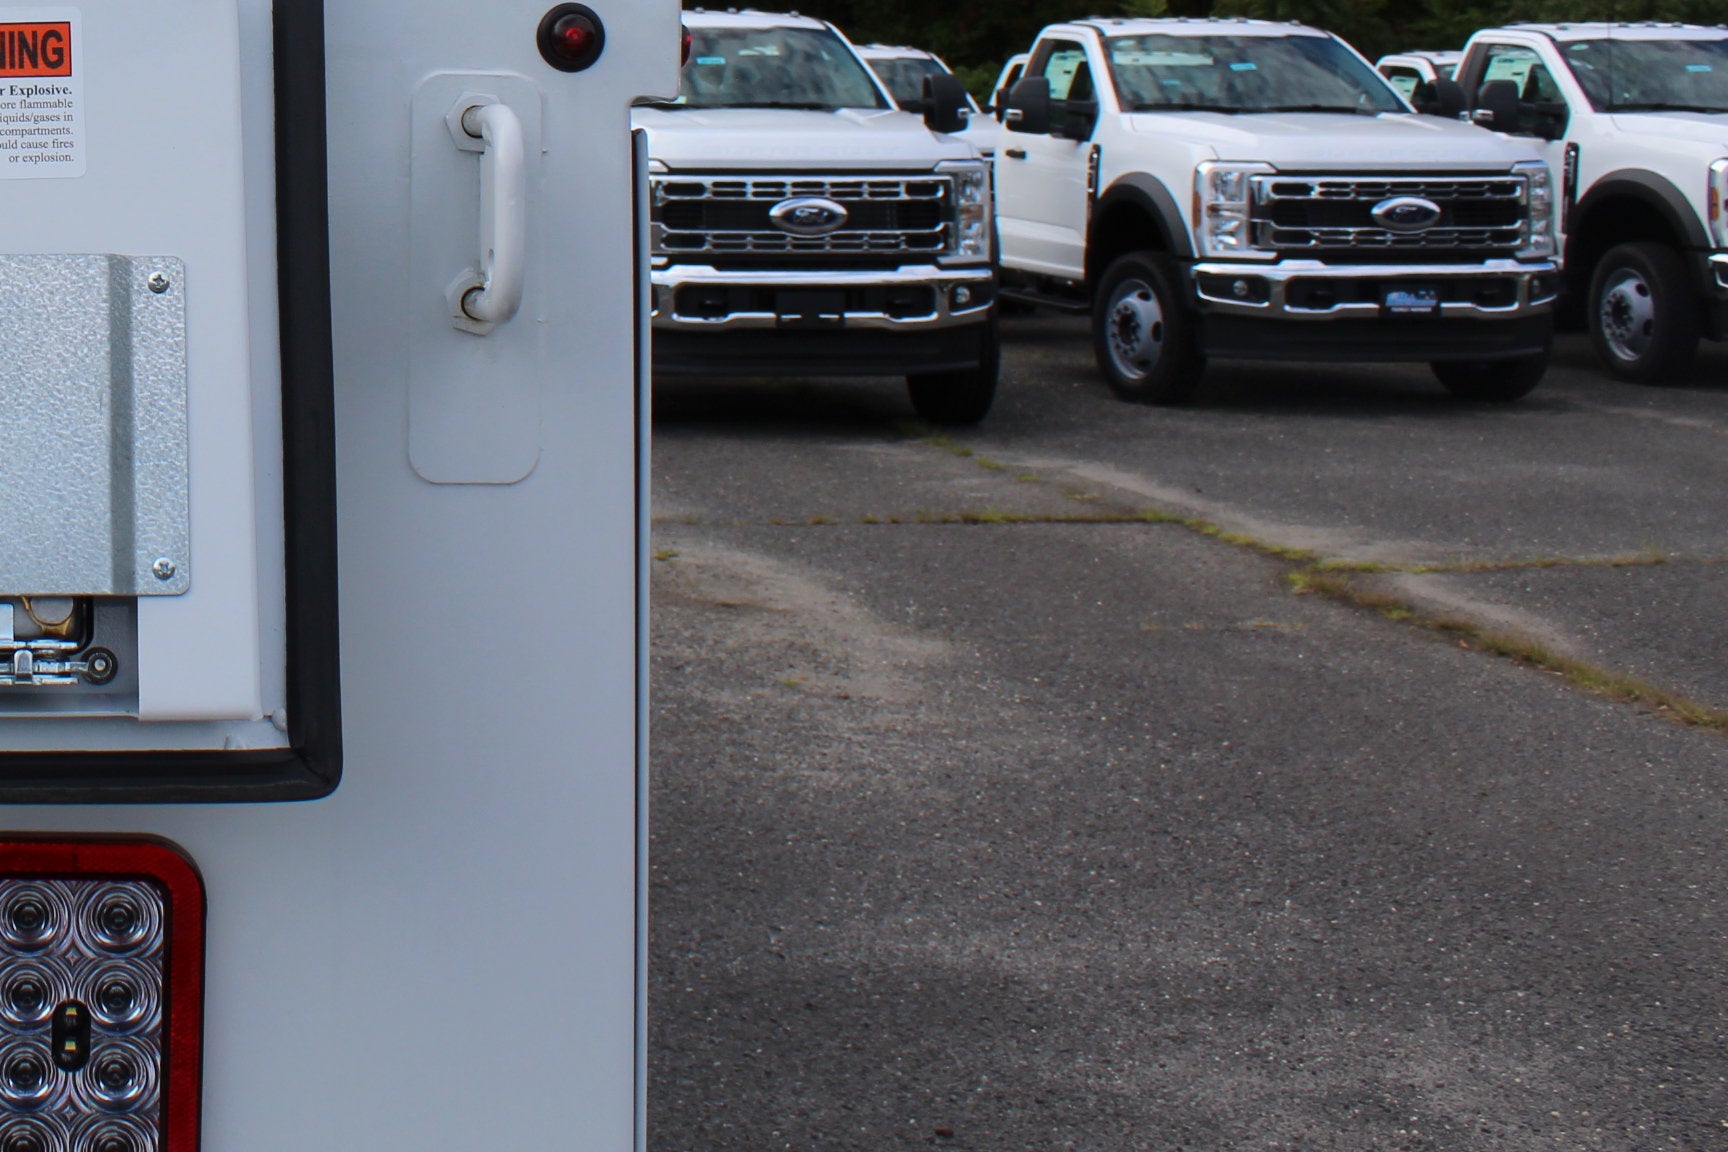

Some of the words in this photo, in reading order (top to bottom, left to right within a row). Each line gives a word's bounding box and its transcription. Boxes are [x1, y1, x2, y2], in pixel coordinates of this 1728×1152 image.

[10, 84, 73, 98] Explosive.
[19, 98, 73, 109] flammable
[63, 112, 73, 121] in
[0, 126, 73, 138] compartments.
[20, 141, 49, 149] cause
[52, 139, 74, 149] fires
[8, 155, 19, 163] or
[22, 152, 74, 164] explosion.
